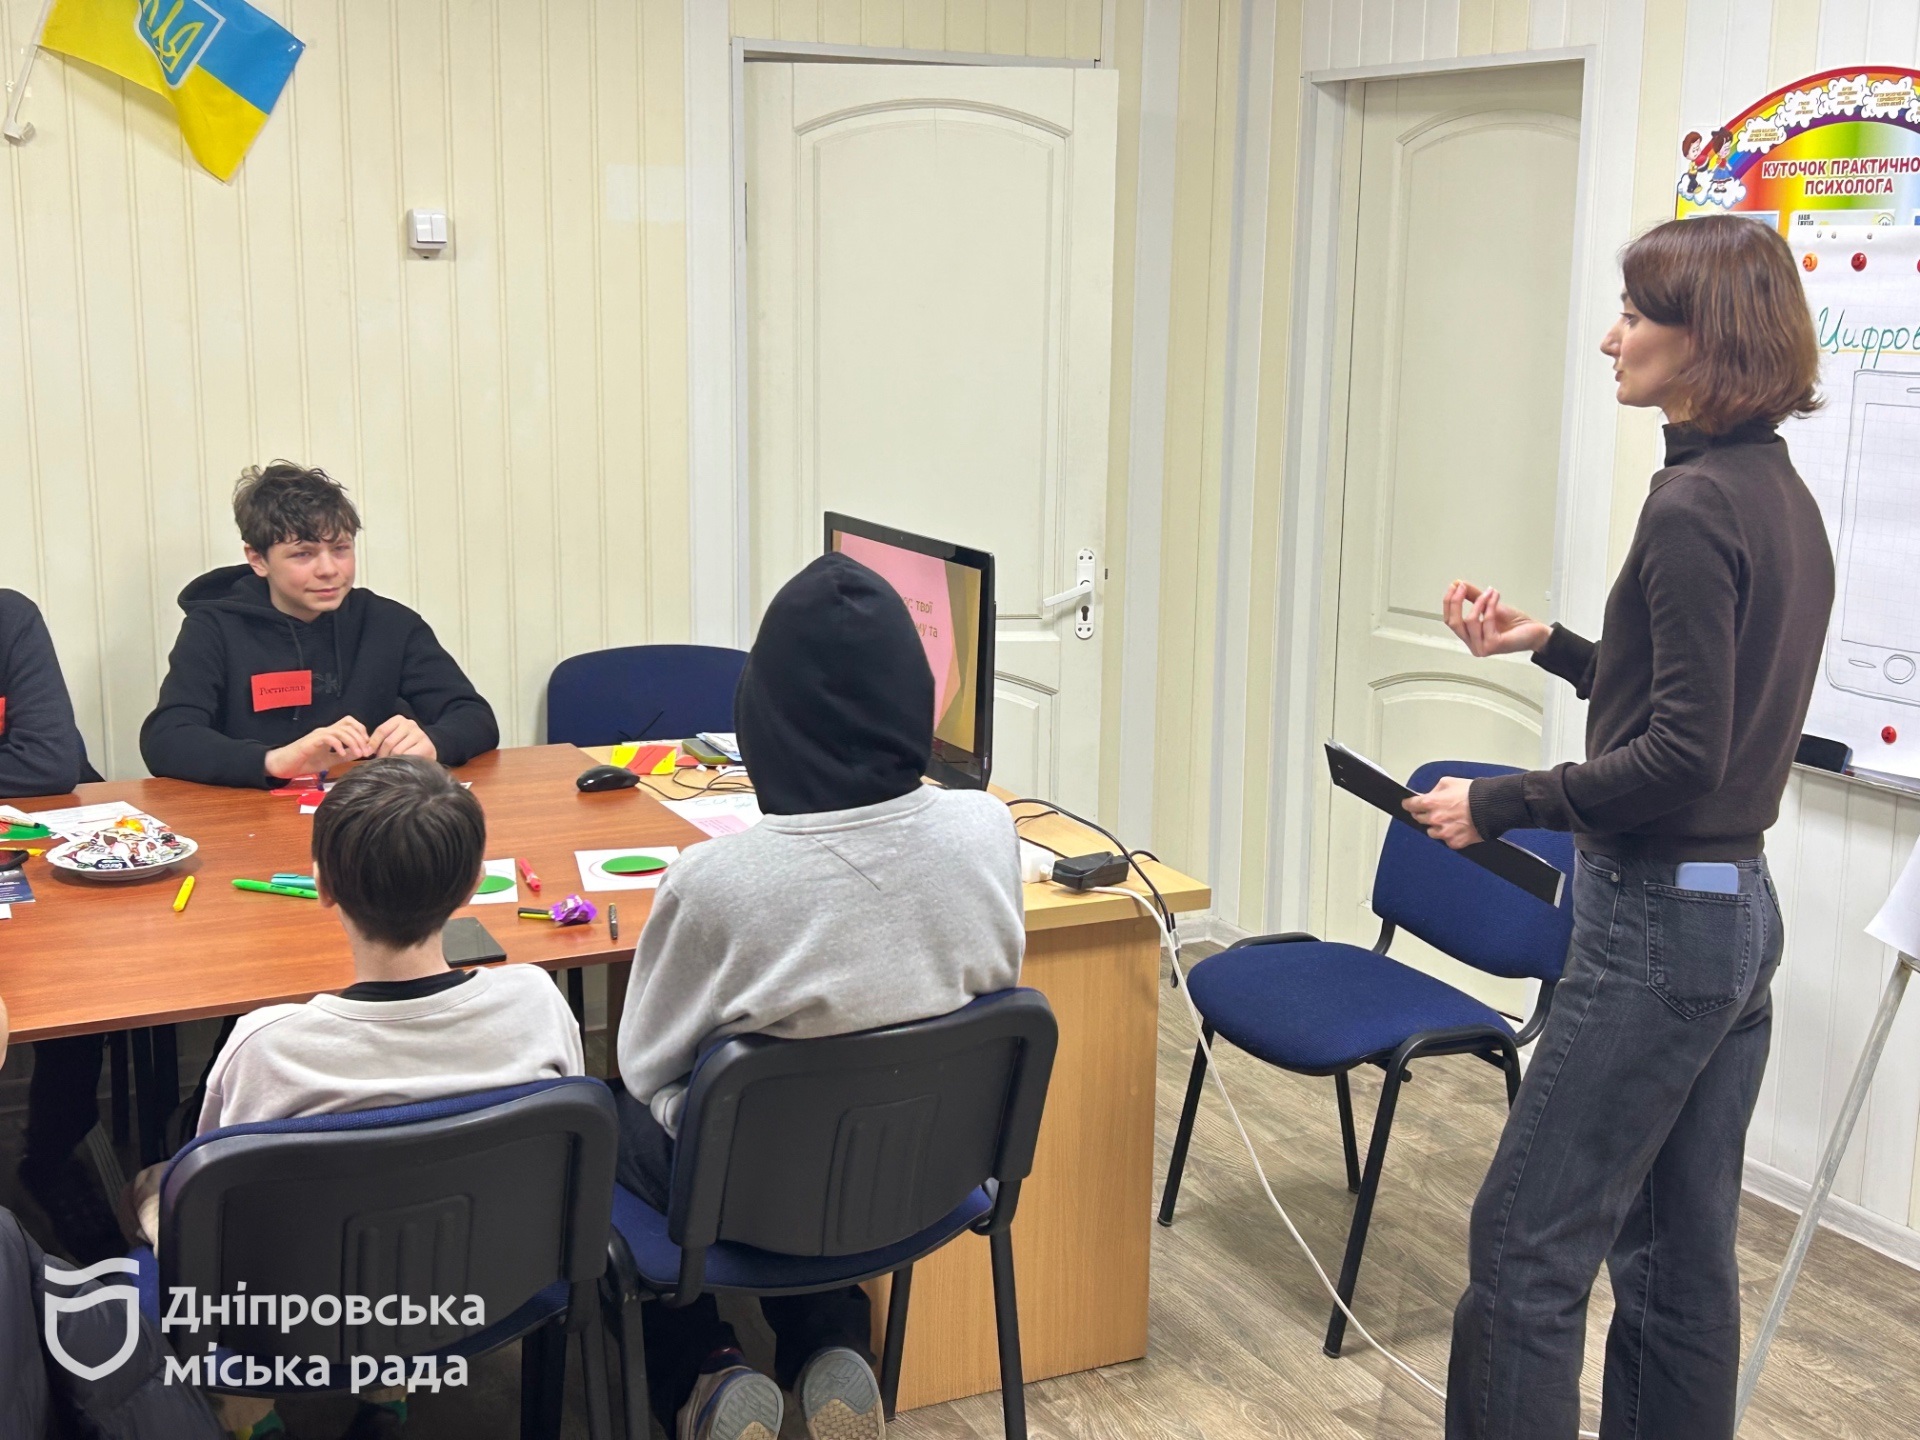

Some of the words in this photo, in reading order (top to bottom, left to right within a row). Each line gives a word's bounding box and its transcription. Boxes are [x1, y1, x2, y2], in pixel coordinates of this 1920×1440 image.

[1762, 160, 1827, 177] КУТОЧОК
[1830, 157, 1920, 175] ПРАКТИЧНО
[1804, 178, 1894, 195] ПСИХОЛОГА
[915, 600, 934, 614] твої
[929, 625, 938, 638] та
